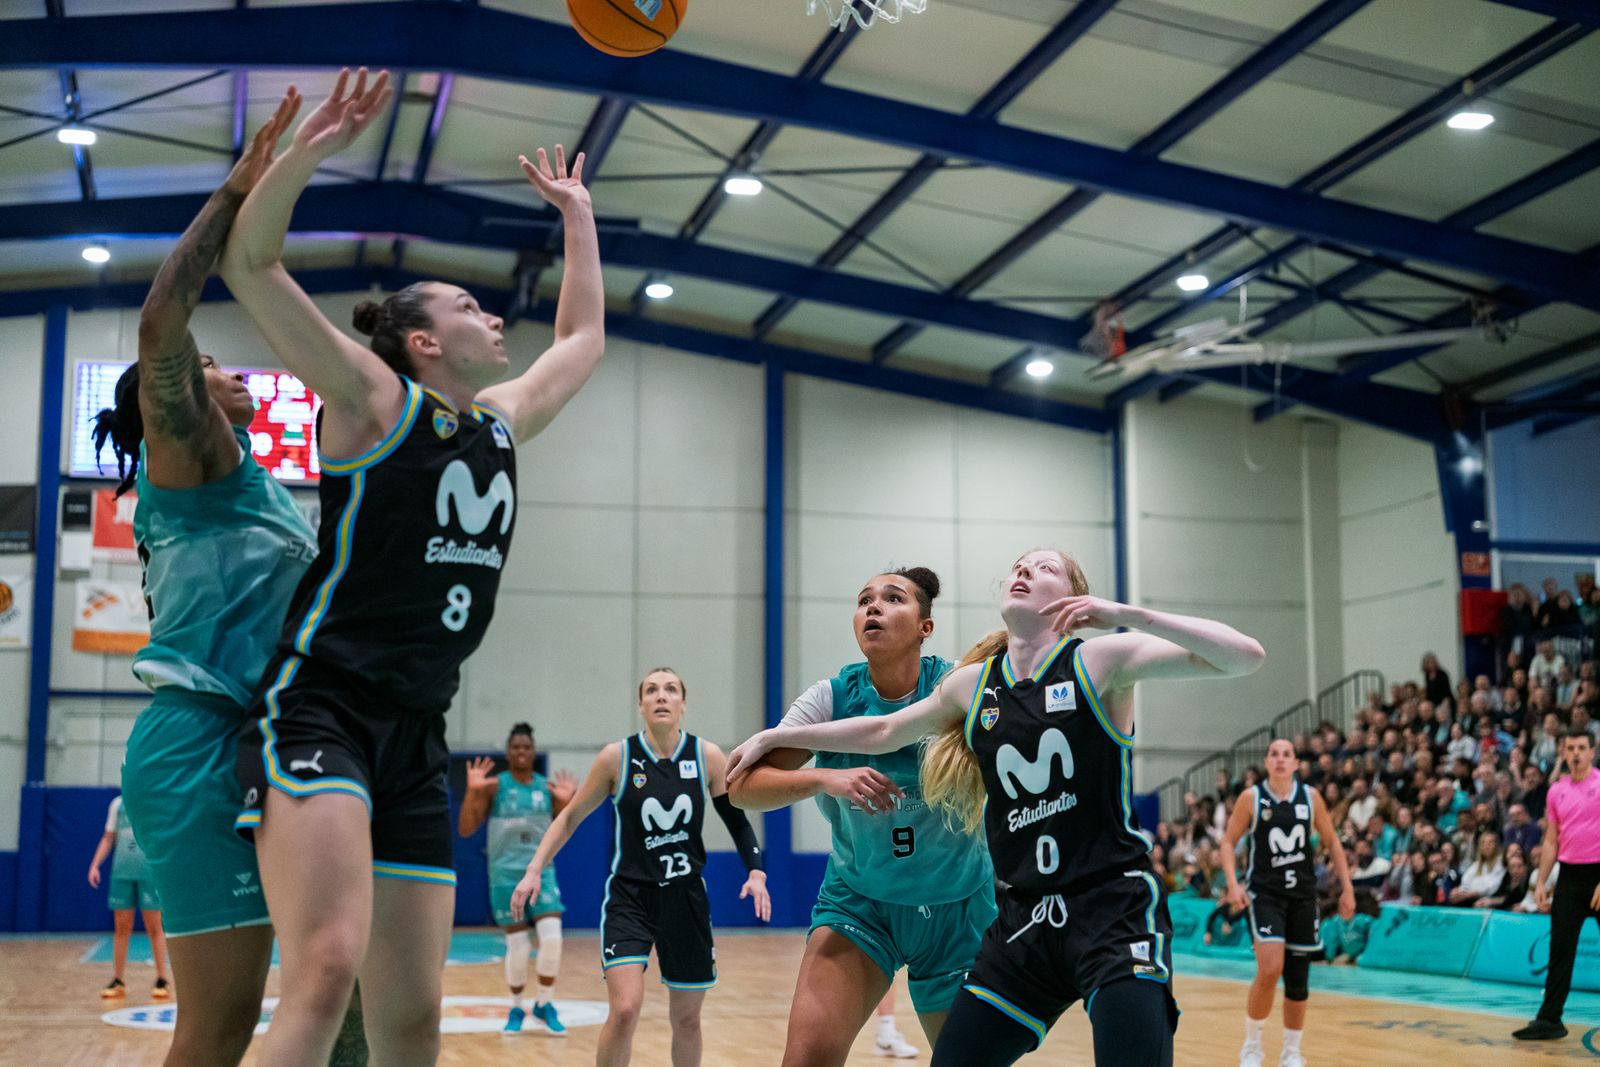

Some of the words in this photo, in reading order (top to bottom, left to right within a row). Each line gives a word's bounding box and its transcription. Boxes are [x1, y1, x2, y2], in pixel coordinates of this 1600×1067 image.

[441, 584, 472, 632] 8
[1008, 791, 1077, 832] Estudiantes
[892, 826, 915, 858] 9
[1036, 835, 1059, 874] 0
[659, 853, 691, 879] 23
[1285, 870, 1297, 888] 5
